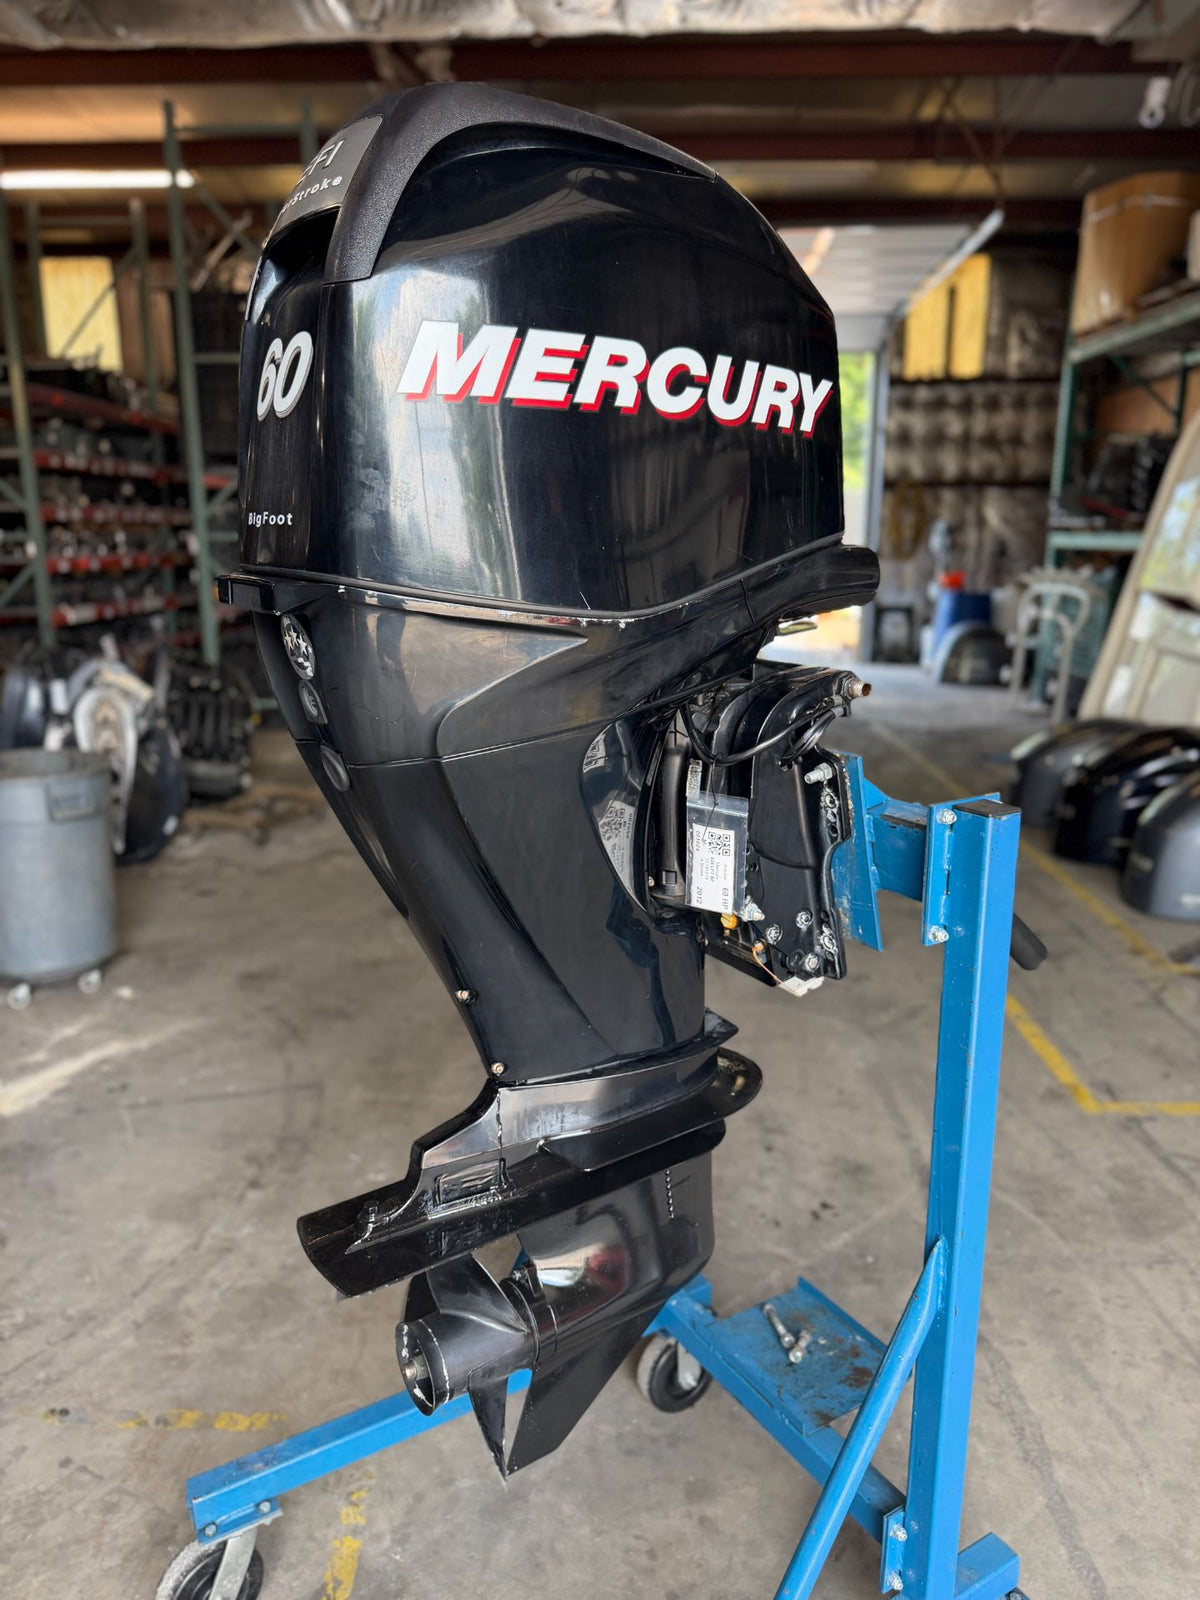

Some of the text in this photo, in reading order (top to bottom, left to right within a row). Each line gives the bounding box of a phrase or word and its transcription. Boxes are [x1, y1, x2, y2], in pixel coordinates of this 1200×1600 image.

[257, 331, 314, 422] 60
[396, 320, 833, 438] MERCURY
[248, 511, 293, 527] BigFoot
[721, 887, 729, 897] 60
[721, 898, 729, 911] HP
